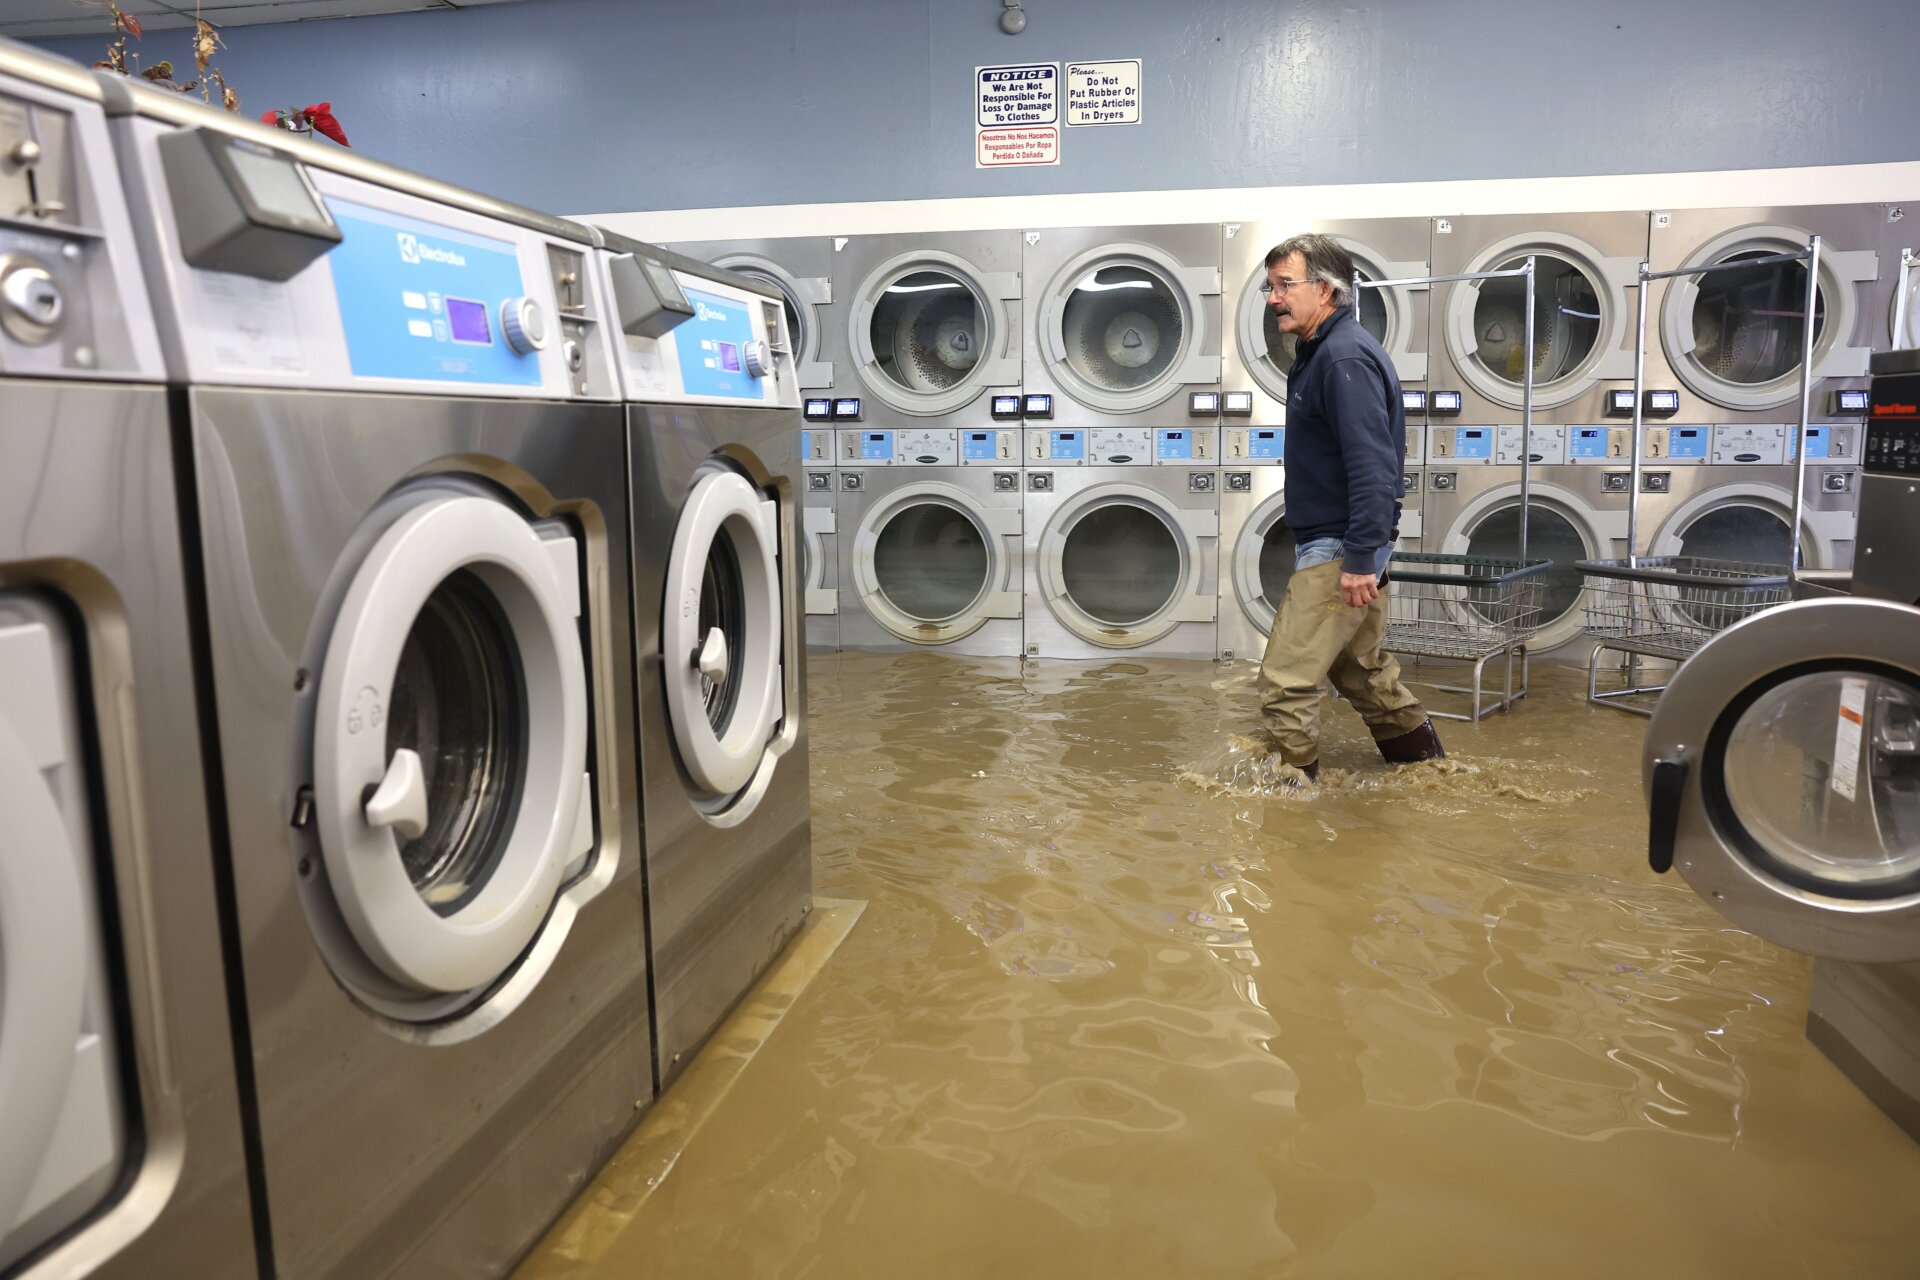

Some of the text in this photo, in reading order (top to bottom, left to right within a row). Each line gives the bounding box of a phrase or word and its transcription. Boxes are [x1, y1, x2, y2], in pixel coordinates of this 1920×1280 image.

[990, 70, 1047, 81] NOTICE
[1087, 76, 1118, 86] Do Not
[992, 82, 1043, 92] We Are Not
[1070, 86, 1136, 98] Put Rubber Or
[982, 92, 1052, 103] Responsible For
[982, 102, 1052, 113] Loss Or Damage
[1070, 98, 1136, 109] Plastic Articles
[995, 112, 1040, 122] To Clothes
[1081, 110, 1124, 121] In Dryers
[984, 142, 1024, 151] Responsables
[1036, 141, 1052, 149] Ropa
[1015, 151, 1021, 159] O
[1658, 216, 1668, 224] 43
